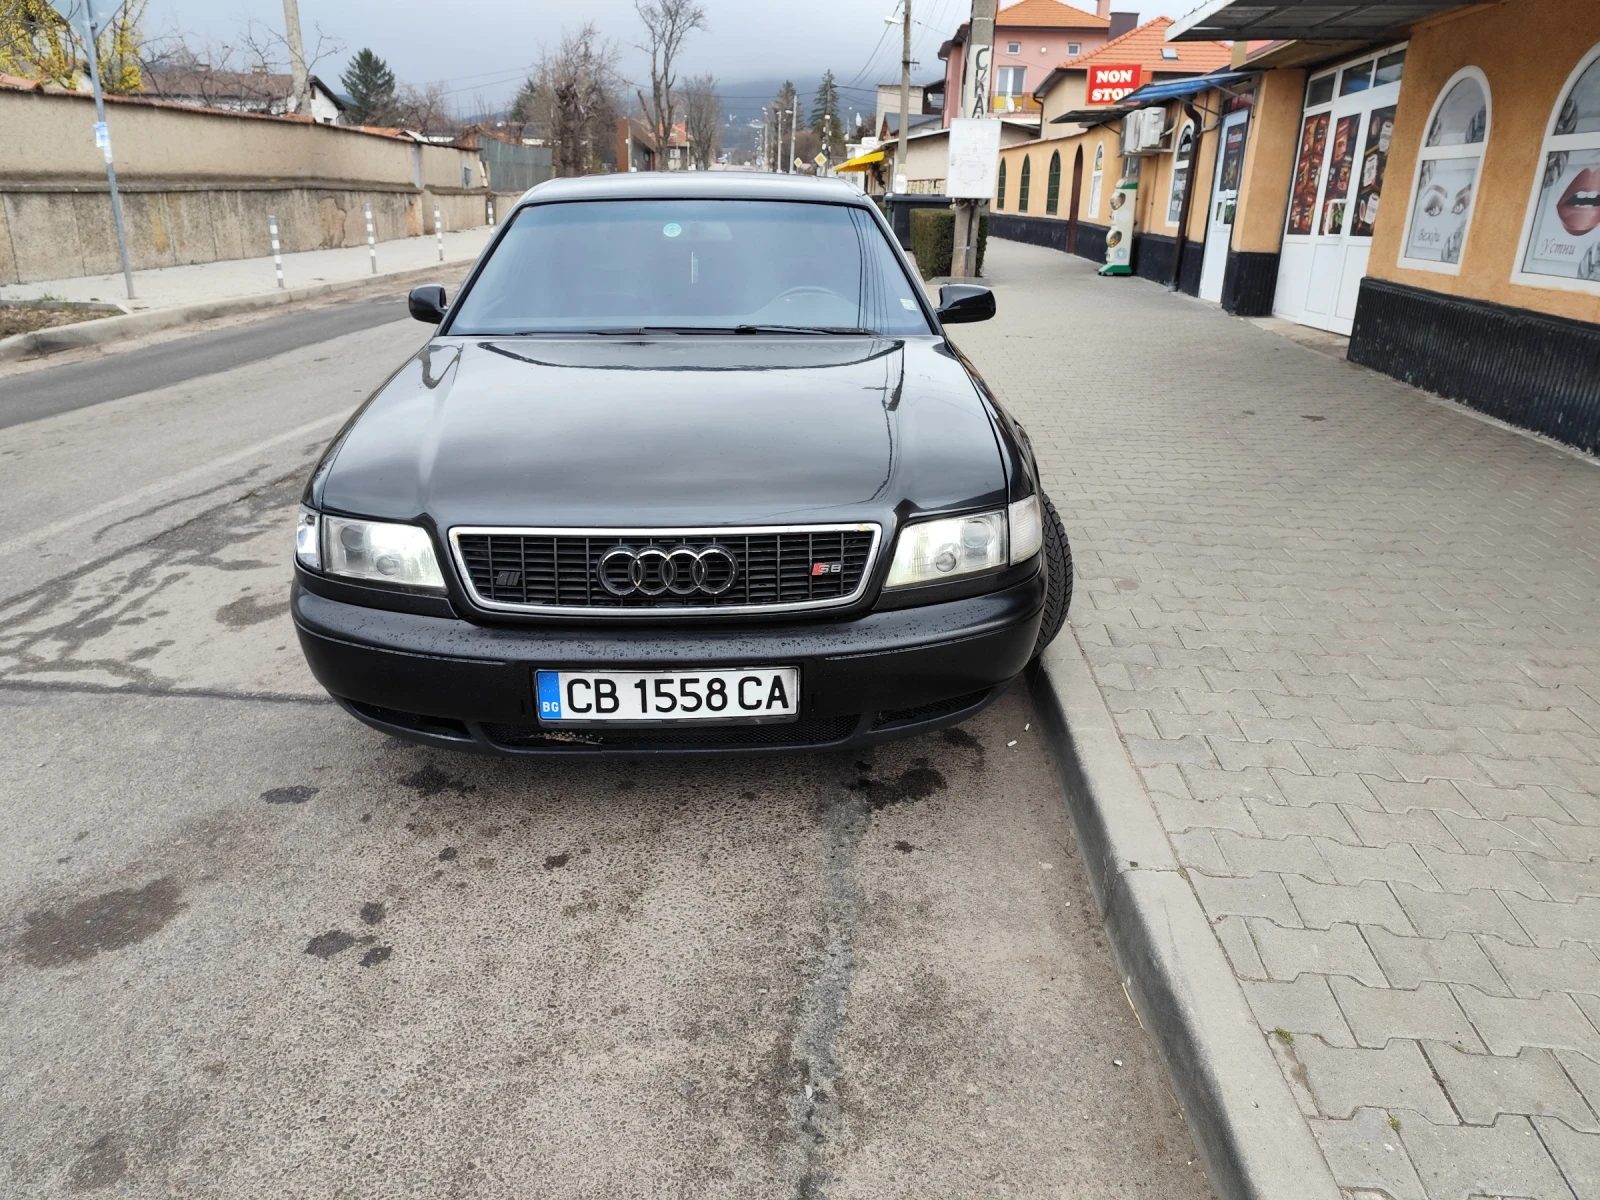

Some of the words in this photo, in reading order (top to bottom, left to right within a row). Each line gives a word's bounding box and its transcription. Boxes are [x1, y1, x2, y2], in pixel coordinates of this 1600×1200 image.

[972, 48, 990, 119] СКА
[1096, 70, 1133, 83] NON
[1540, 237, 1577, 256] Устни
[566, 678, 620, 714] CB
[634, 677, 729, 714] 1558
[737, 675, 790, 711] CA
[542, 702, 560, 713] BG
